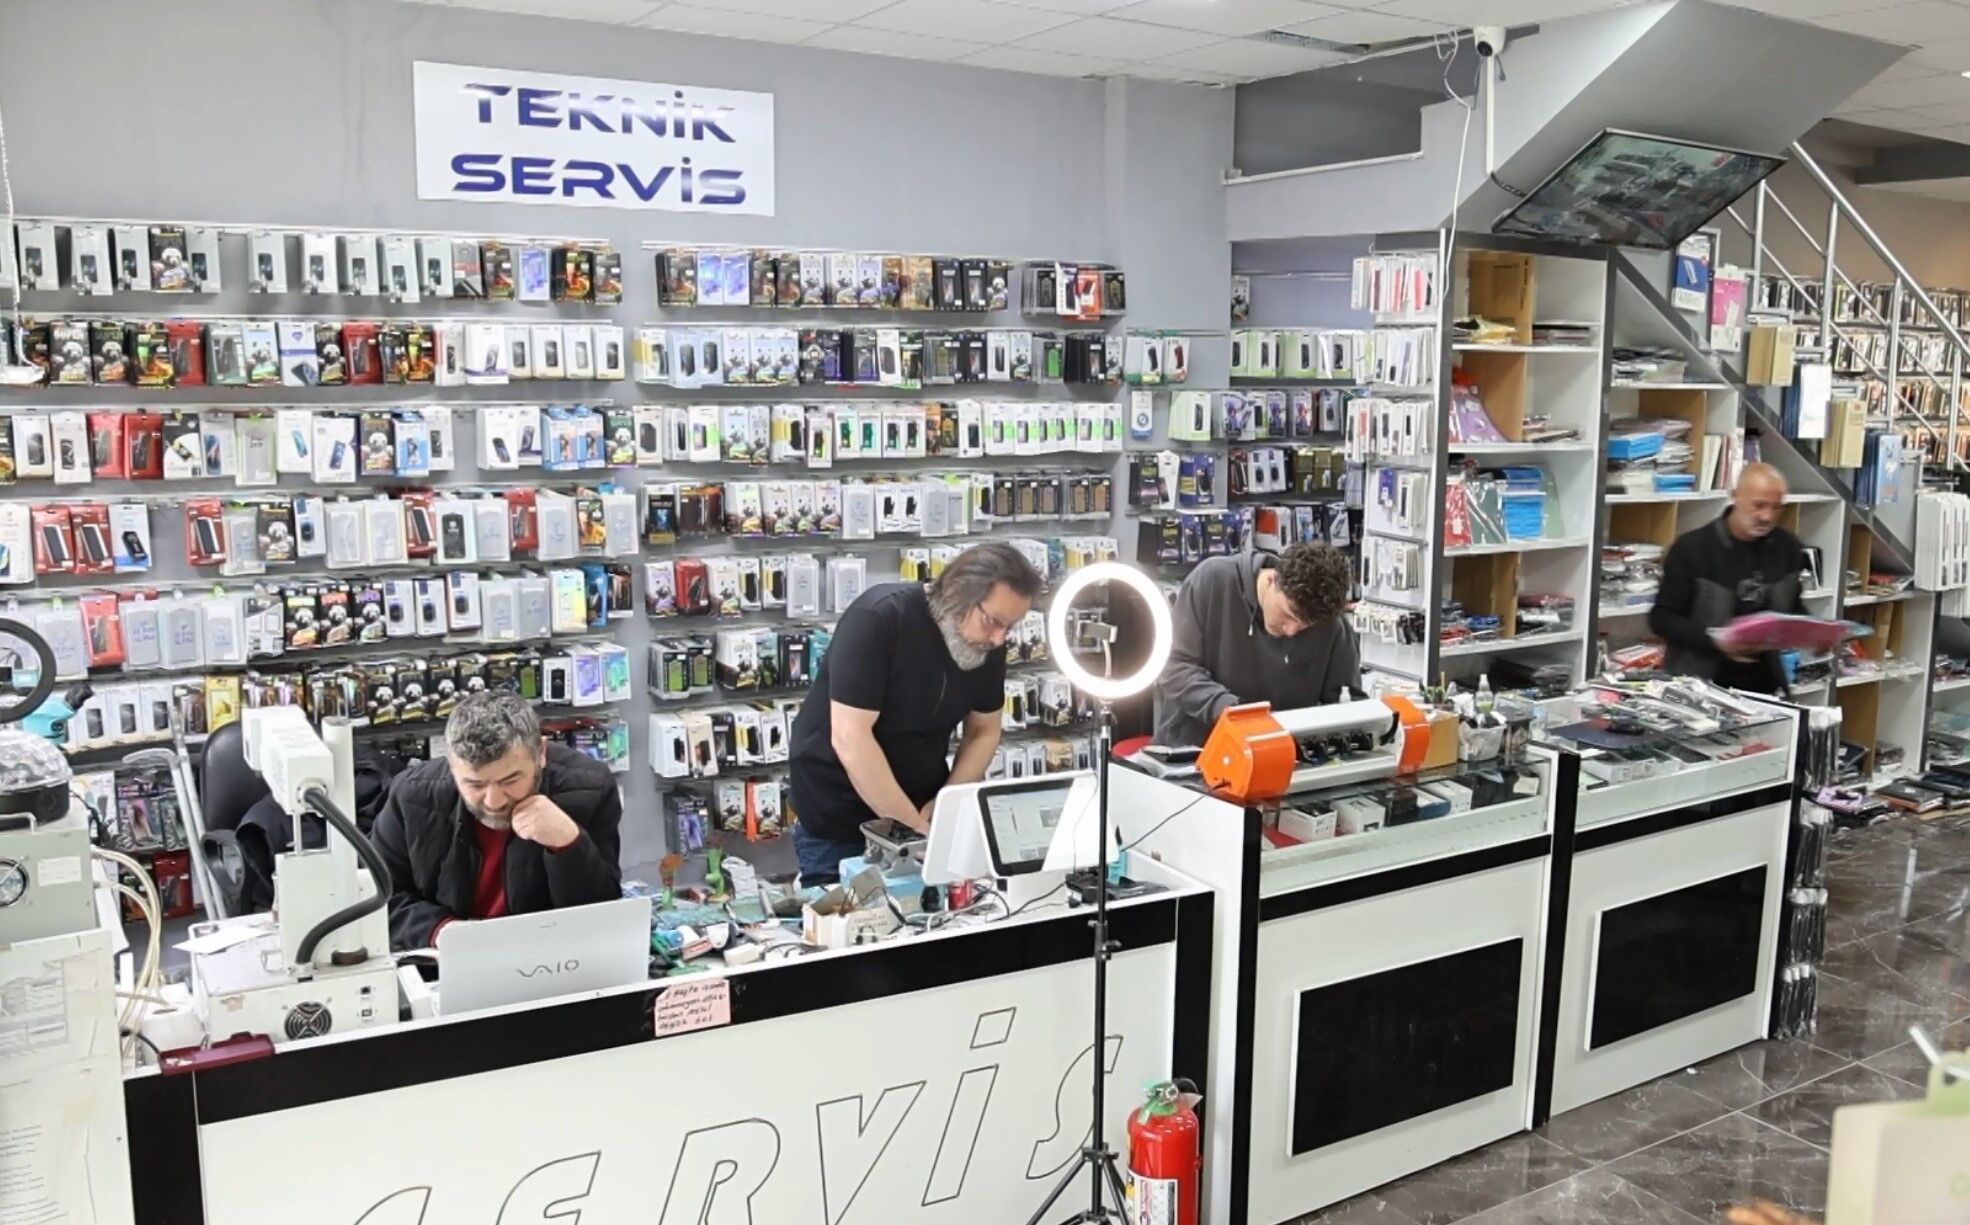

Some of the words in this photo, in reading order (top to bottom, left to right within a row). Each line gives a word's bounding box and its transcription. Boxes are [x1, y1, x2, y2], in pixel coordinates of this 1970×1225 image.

[461, 82, 736, 143] TEKNİK
[450, 153, 747, 205] SERVİS
[516, 959, 580, 978] VAIO
